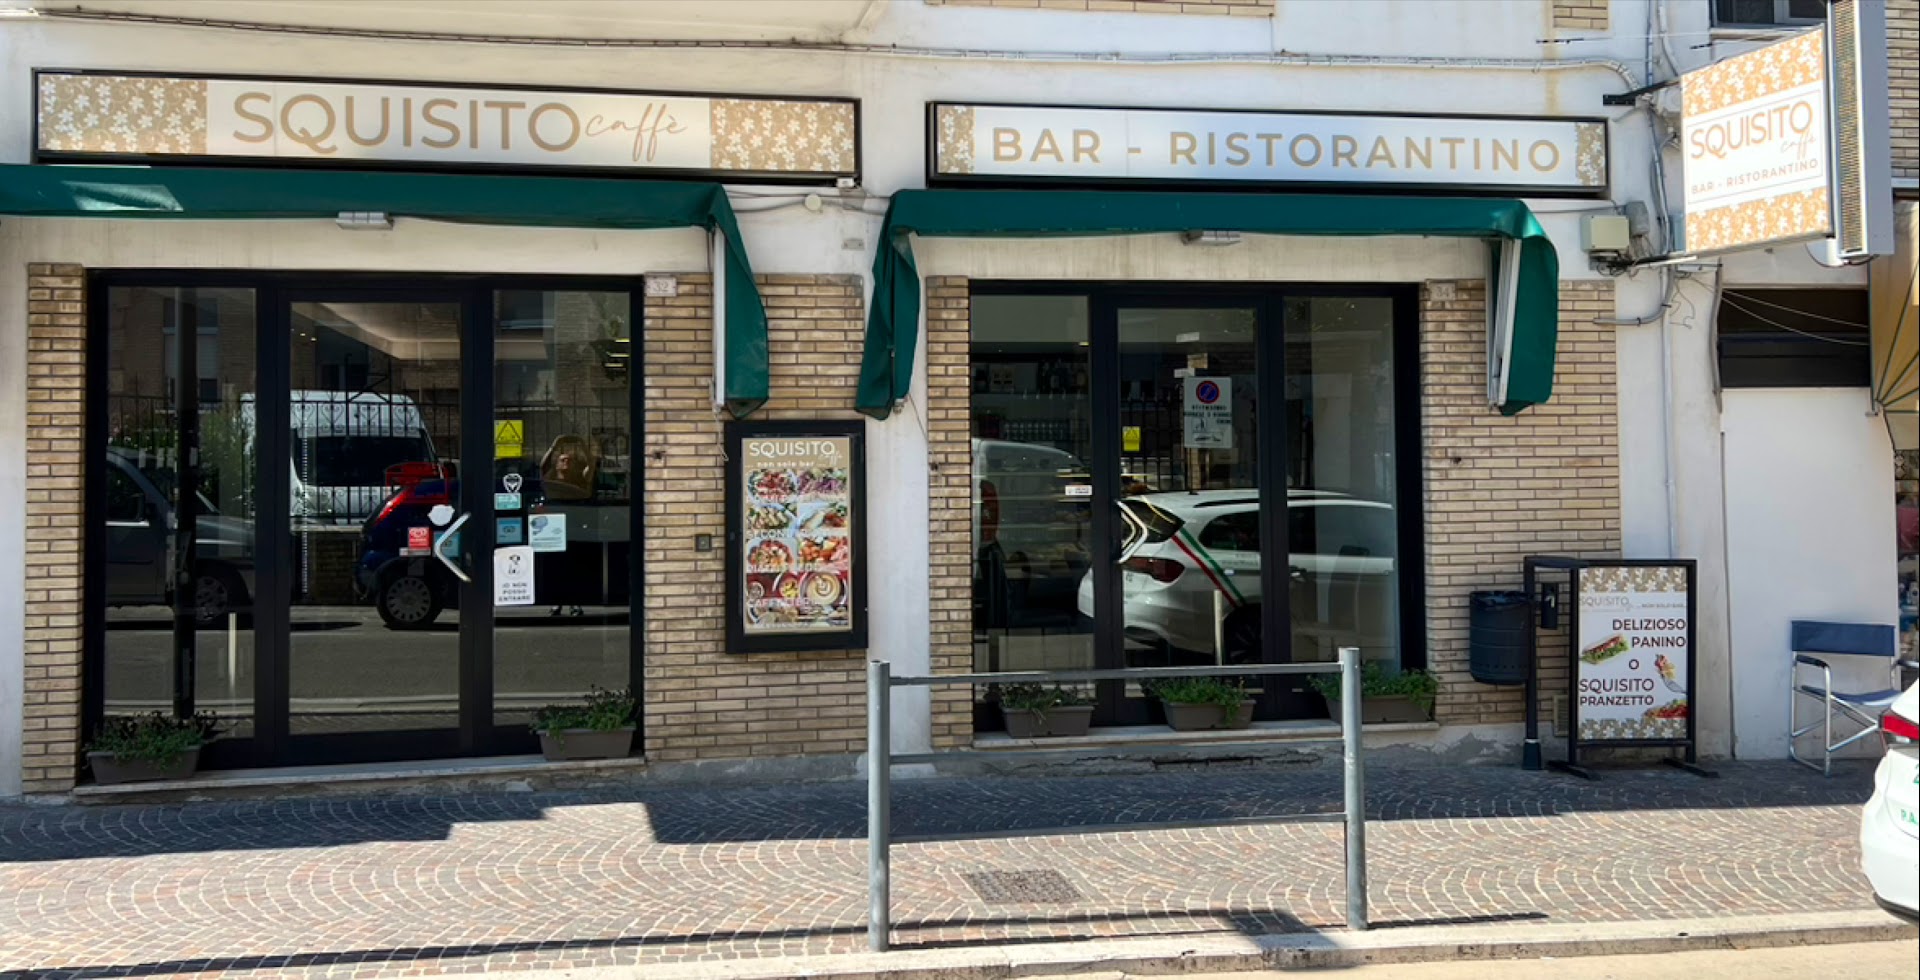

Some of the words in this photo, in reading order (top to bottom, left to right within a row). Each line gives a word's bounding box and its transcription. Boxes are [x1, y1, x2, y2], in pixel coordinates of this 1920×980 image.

[233, 92, 580, 153] SQUISITO
[586, 103, 688, 162] caffè
[1691, 101, 1813, 158] SQUISITO
[992, 127, 1100, 163] BAR
[1170, 131, 1560, 172] RISTORANTINO
[1691, 181, 1714, 194] BAR
[1727, 158, 1818, 186] RISTORANTINO
[749, 441, 835, 459] SQUISITO
[1612, 618, 1686, 630] DELIZIOSO
[1632, 636, 1686, 648] PANINO
[1628, 658, 1640, 670] O
[1579, 678, 1654, 694] SQUISITO
[1580, 694, 1654, 706] PRANZETTO
